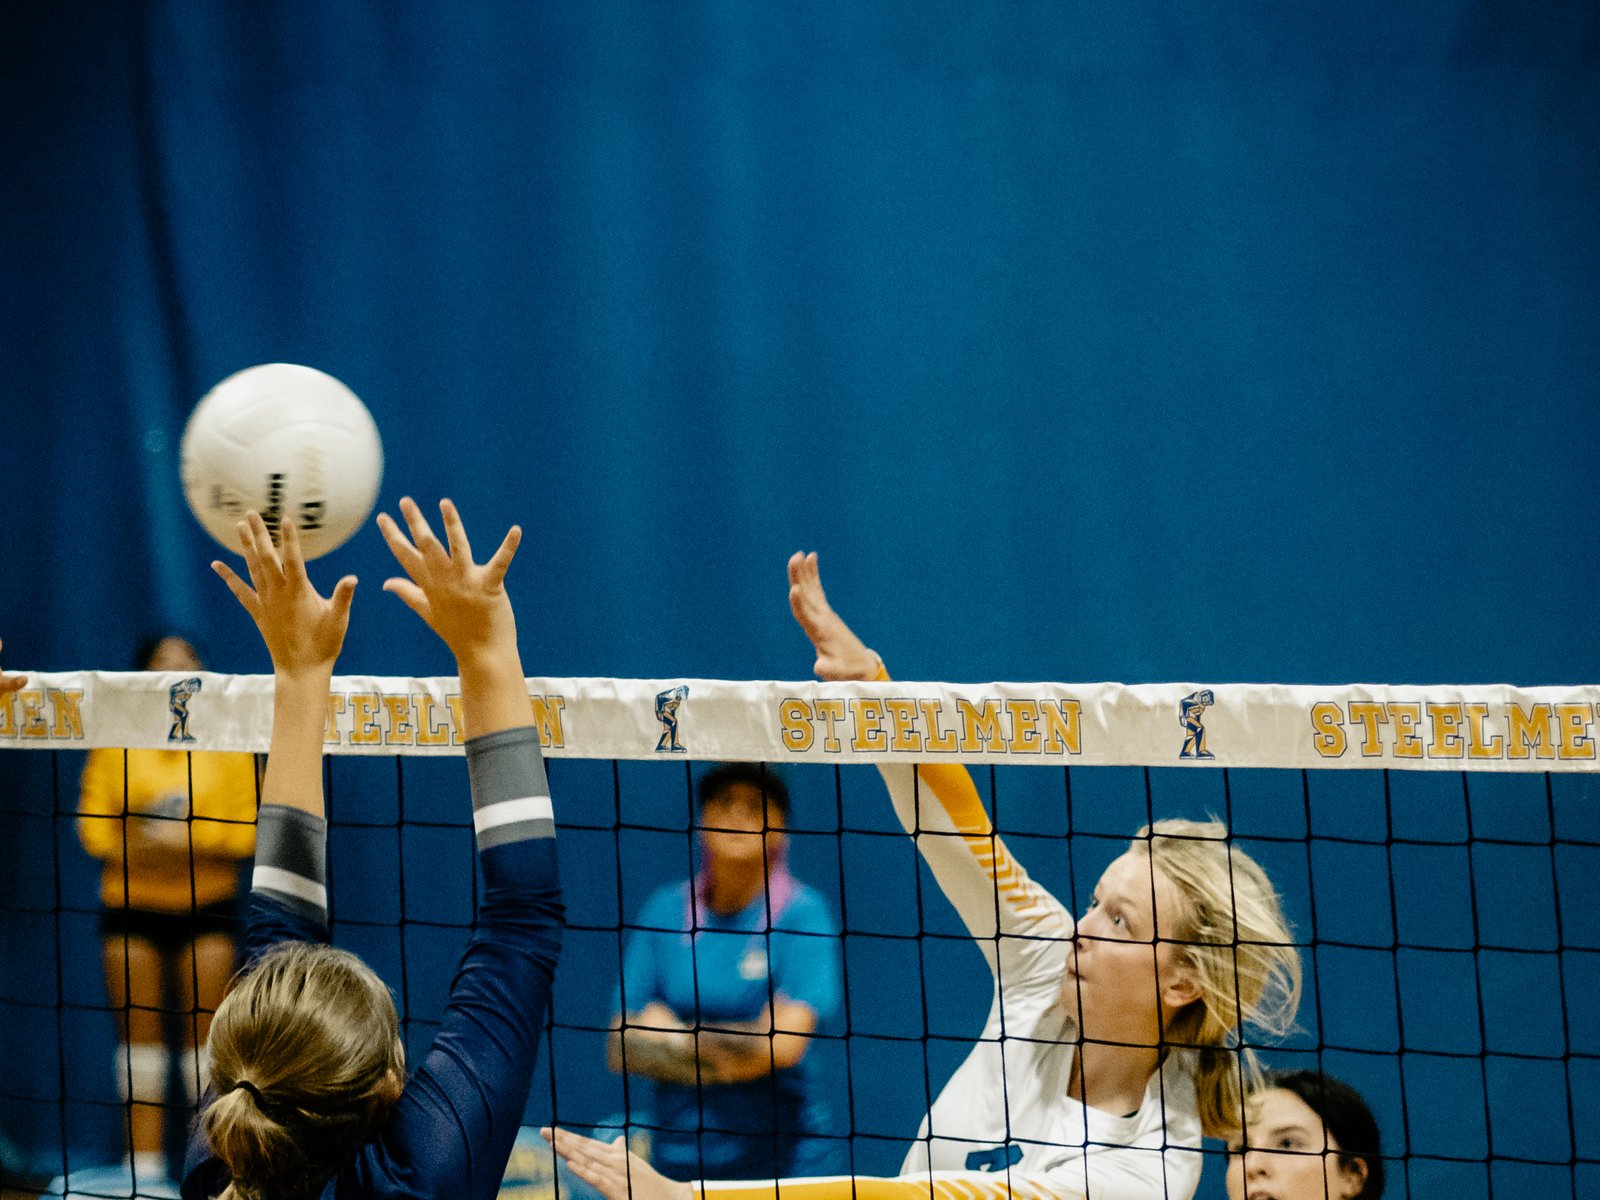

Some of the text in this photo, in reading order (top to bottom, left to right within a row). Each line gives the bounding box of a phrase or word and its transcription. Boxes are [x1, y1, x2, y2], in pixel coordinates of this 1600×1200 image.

[323, 692, 566, 749] TEELN
[779, 697, 1083, 755] STEELMEN
[1310, 700, 1600, 760] STEELME
